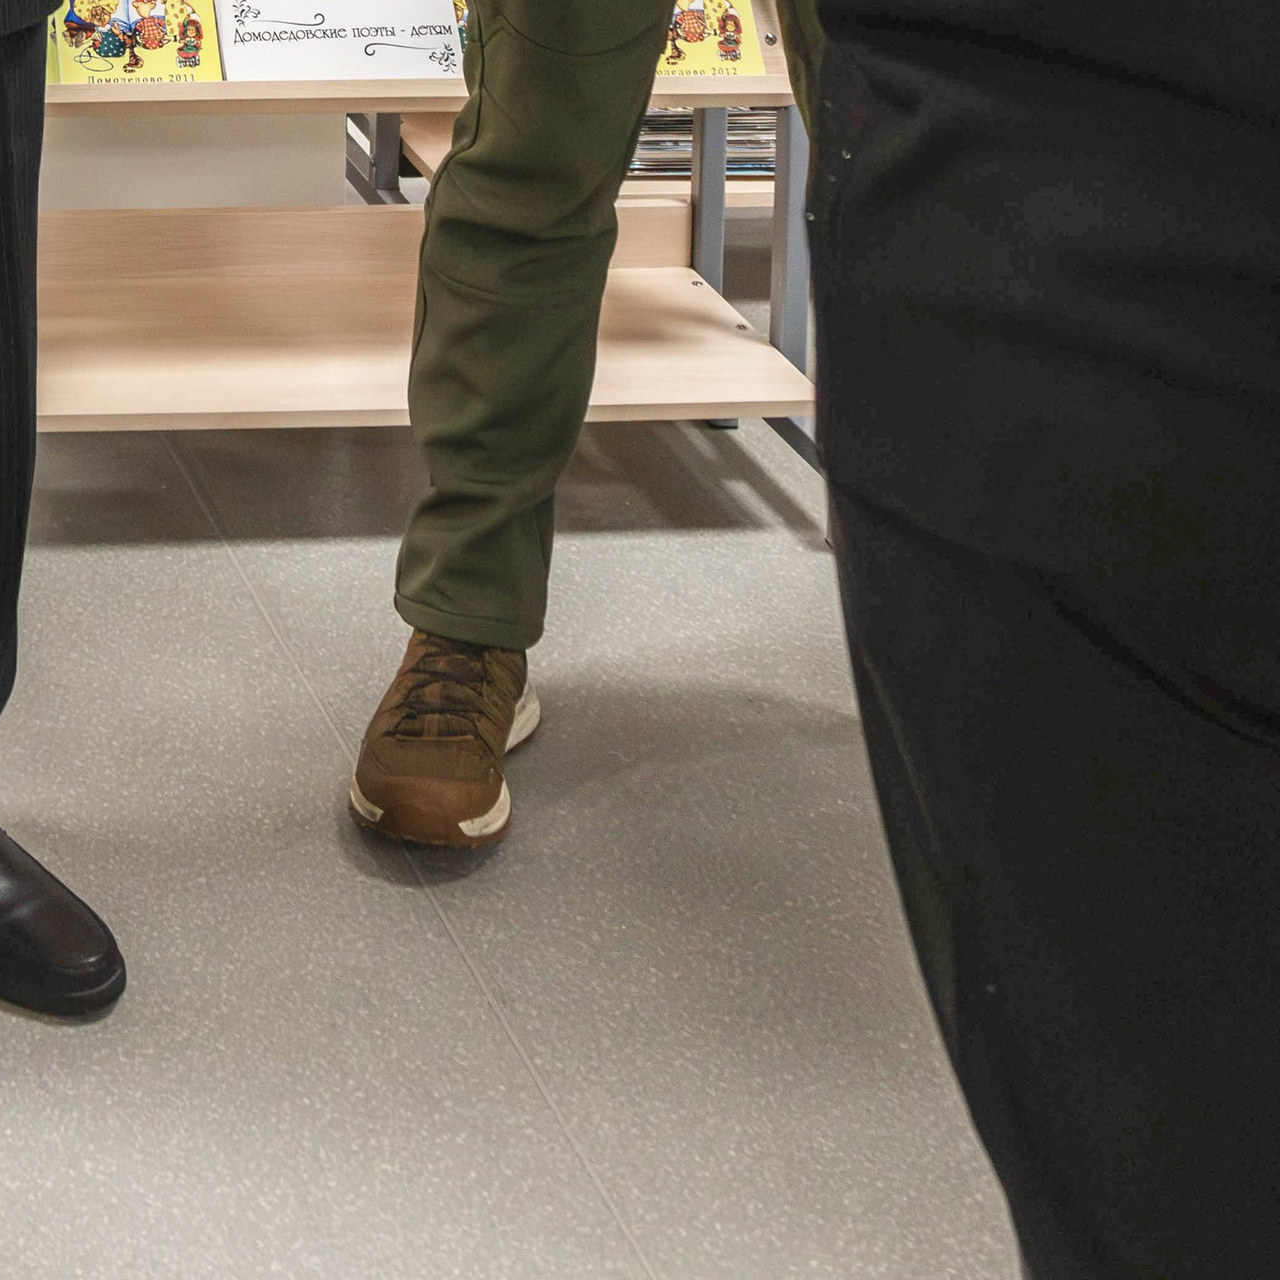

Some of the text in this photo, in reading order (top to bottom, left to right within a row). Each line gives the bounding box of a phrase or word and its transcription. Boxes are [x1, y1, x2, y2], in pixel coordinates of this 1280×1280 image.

[233, 26, 348, 46] Домодедовские
[352, 25, 396, 38] поэты
[411, 24, 453, 38] детям
[656, 67, 738, 76] одедово 2012
[169, 74, 195, 83] 2011
